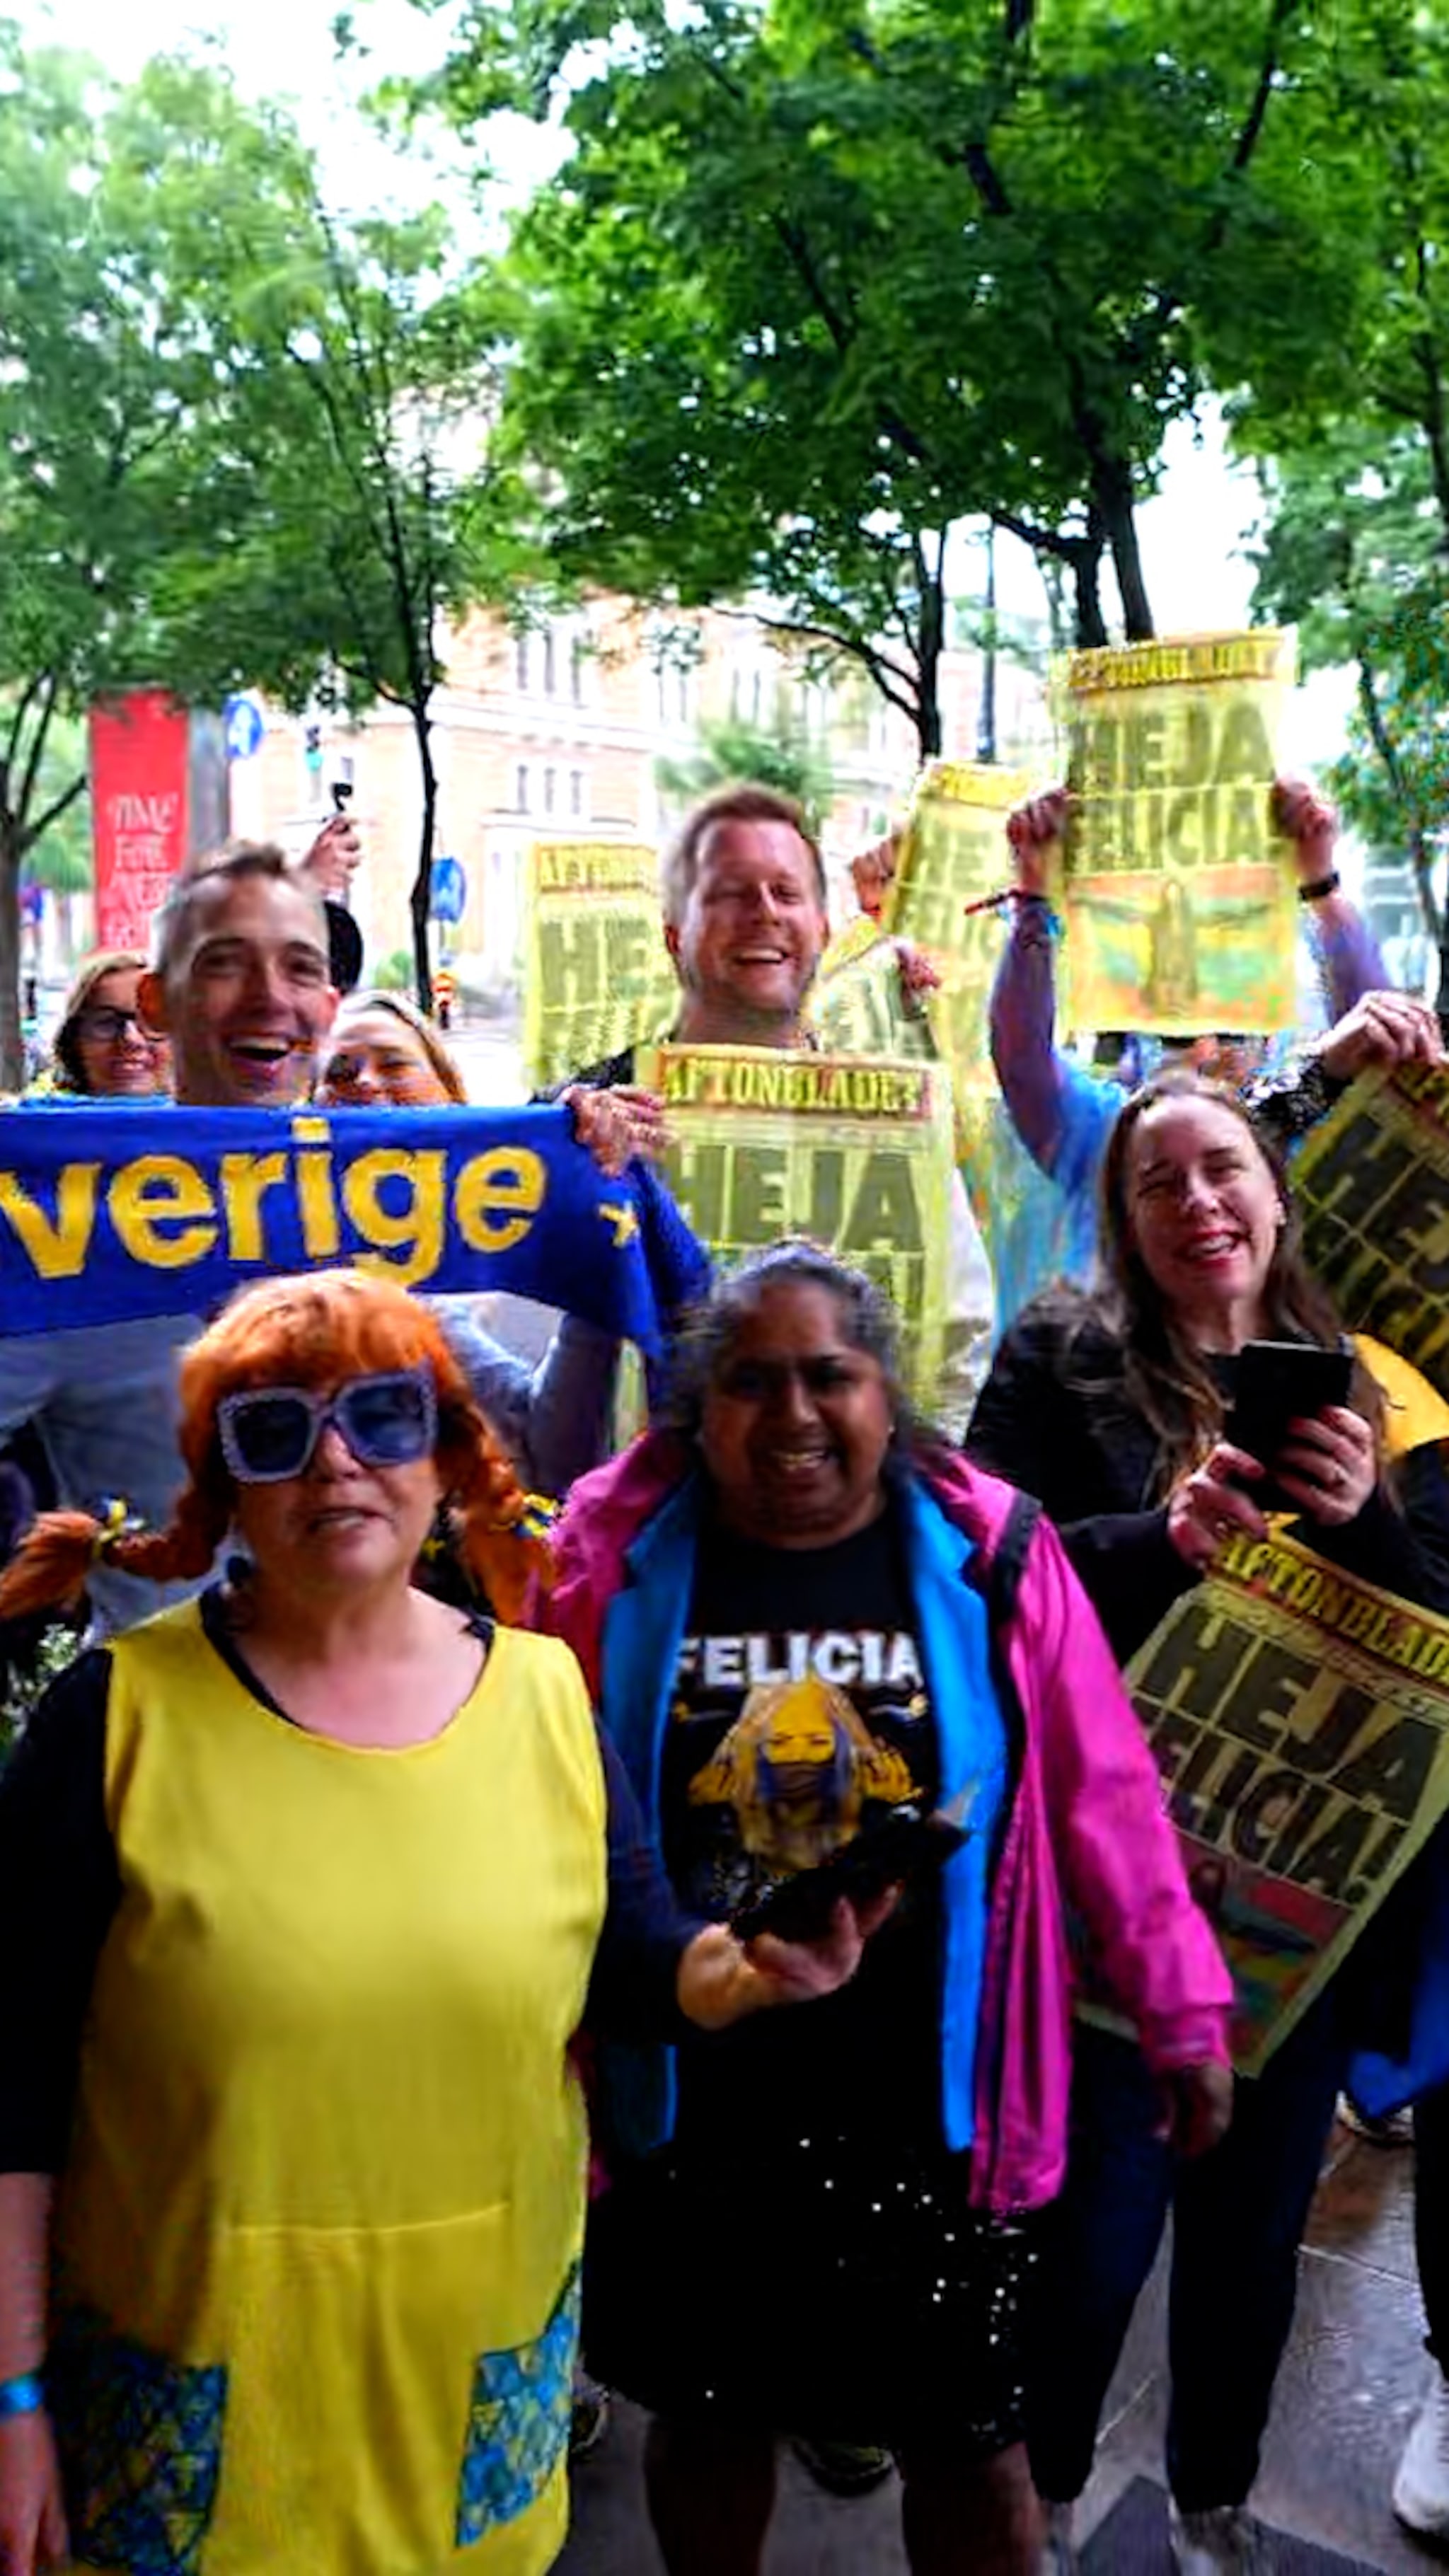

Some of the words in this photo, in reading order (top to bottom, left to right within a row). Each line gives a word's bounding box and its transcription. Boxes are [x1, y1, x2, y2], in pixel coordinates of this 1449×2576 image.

[1066, 702, 1276, 792] HEJA
[0, 1116, 548, 1289] verige
[664, 1142, 924, 1252] HEJA
[677, 1631, 923, 1685] FELICIA
[1223, 1540, 1449, 1682] AFTONBLAD
[1137, 1603, 1442, 1824] HEJA
[1135, 1697, 1409, 1905] ELICIA!
